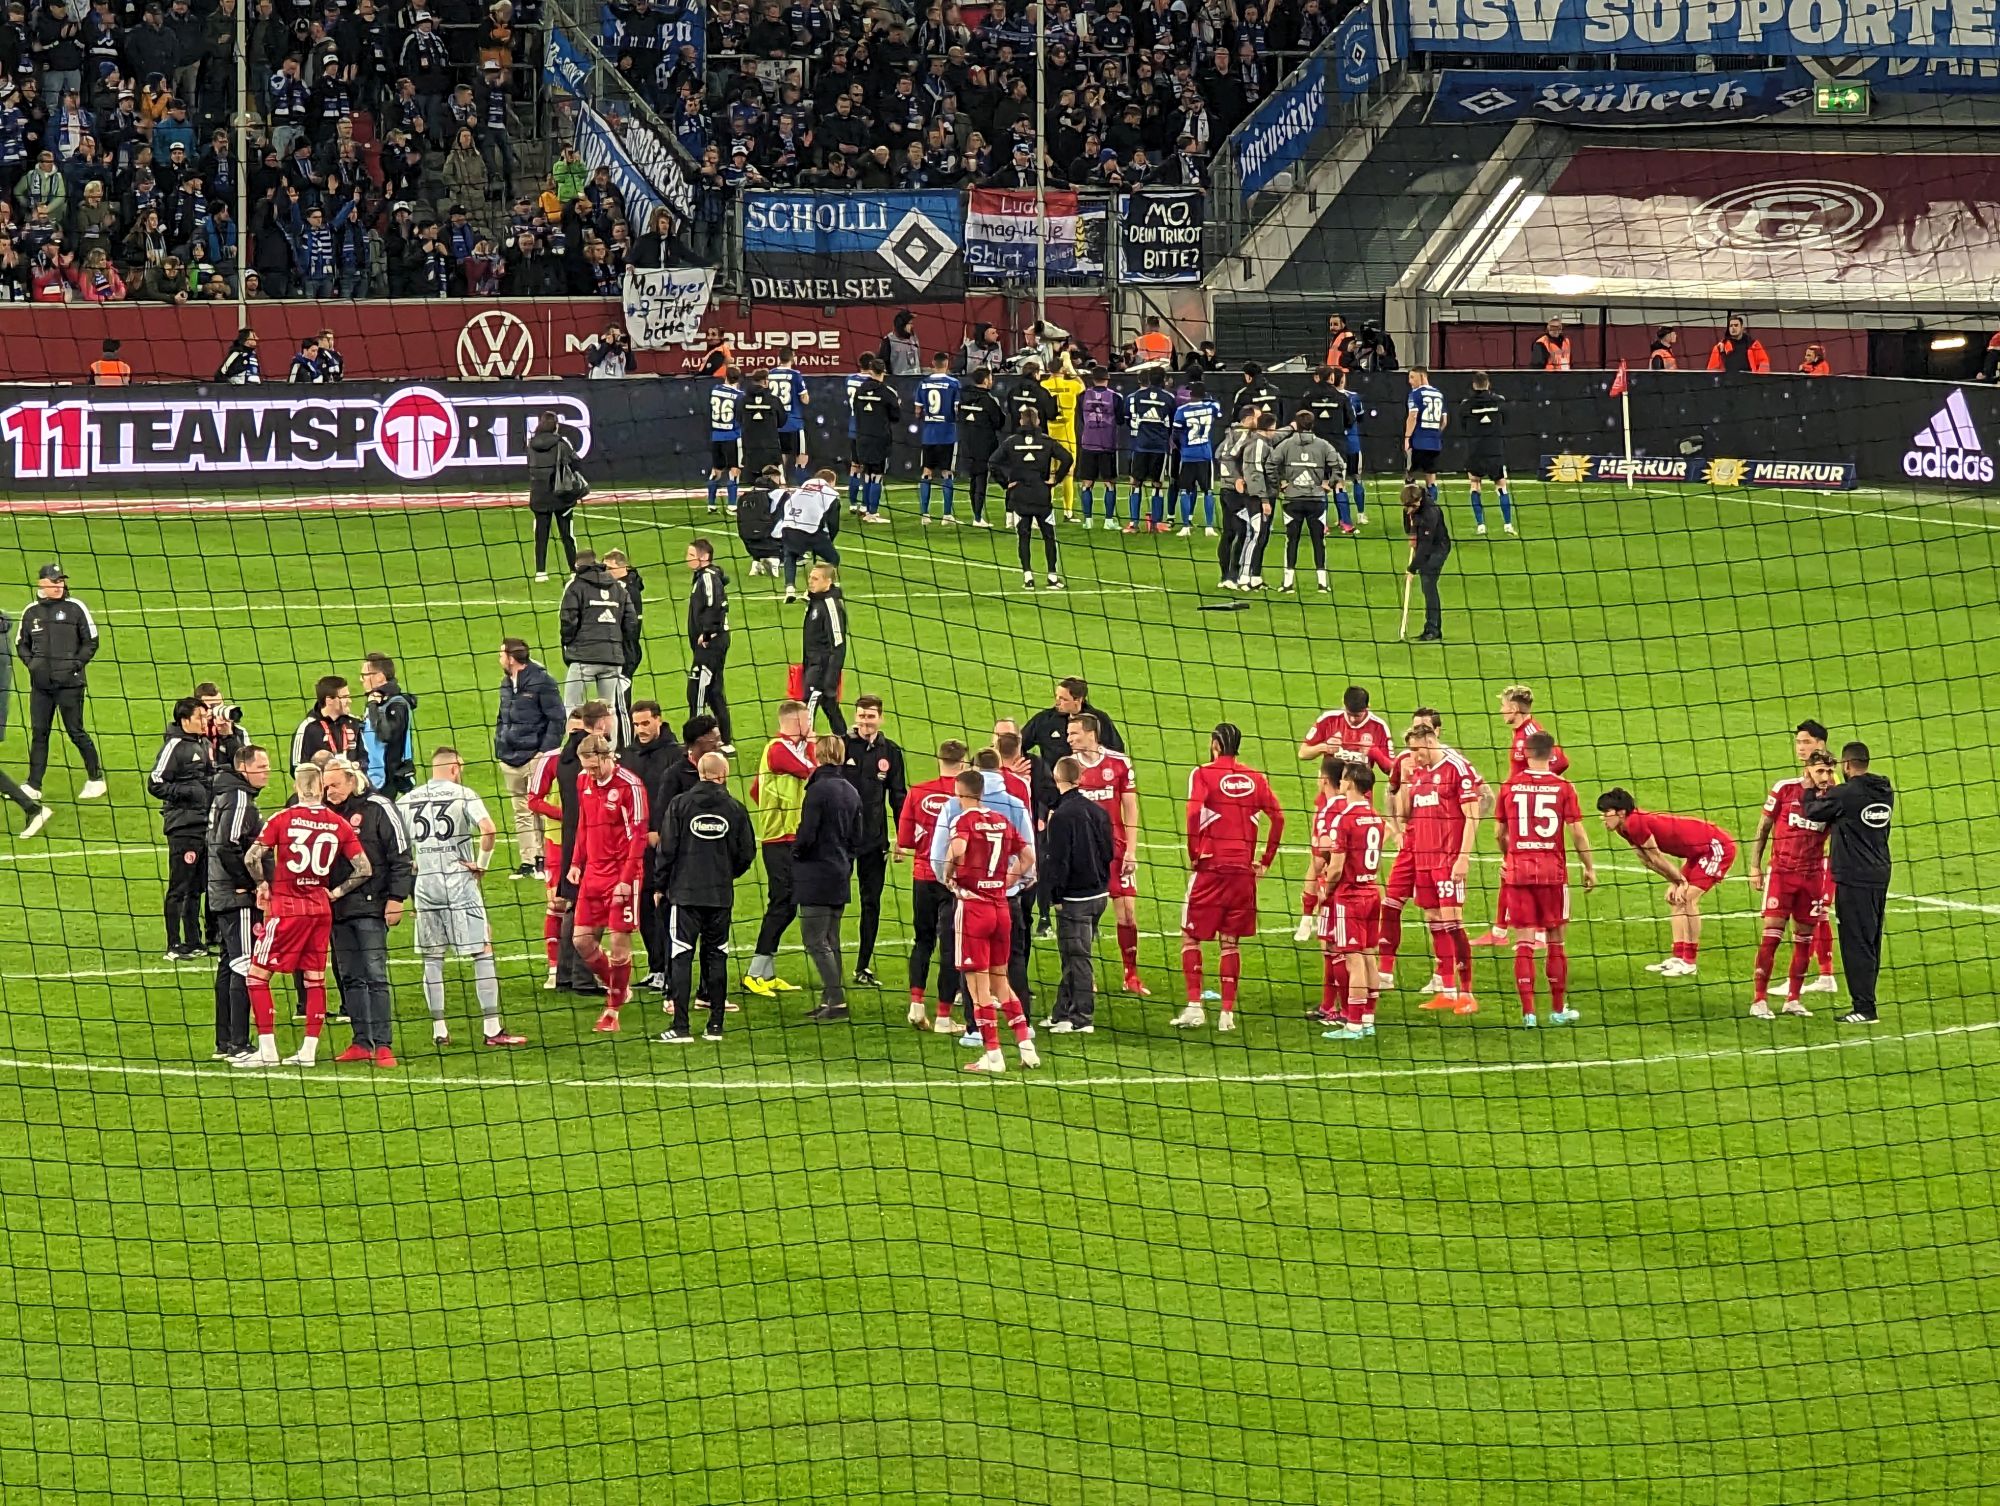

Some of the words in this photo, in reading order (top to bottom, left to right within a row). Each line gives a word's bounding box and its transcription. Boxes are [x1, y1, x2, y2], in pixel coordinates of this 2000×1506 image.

[1409, 0, 1564, 41] HSV
[1584, 0, 2000, 46] SUPPORTE
[1533, 78, 1748, 113] Lübeck
[747, 201, 888, 233] SCHOLLI
[1145, 202, 1192, 227] MO,
[981, 222, 1017, 241] mag
[1130, 226, 1158, 244] DEIN
[1160, 226, 1203, 245] TRIKOT
[969, 244, 1022, 268] Shirt
[1144, 249, 1198, 270] BITTE?
[630, 274, 656, 297] Mo
[750, 277, 894, 300] DIEMELSEE
[710, 396, 735, 422] 36
[928, 389, 941, 414] 9
[1421, 397, 1443, 422] 28
[1186, 415, 1212, 446] 27
[1598, 459, 1687, 477] MERKUR
[1753, 463, 1844, 481] MERKUR
[1903, 447, 1994, 482] adidas
[409, 800, 455, 842] 33
[1512, 793, 1559, 838] 15
[286, 828, 339, 876] 30
[986, 832, 1004, 878] 7
[1364, 826, 1381, 871] 8
[1436, 880, 1455, 898] 39
[623, 906, 634, 923] 5
